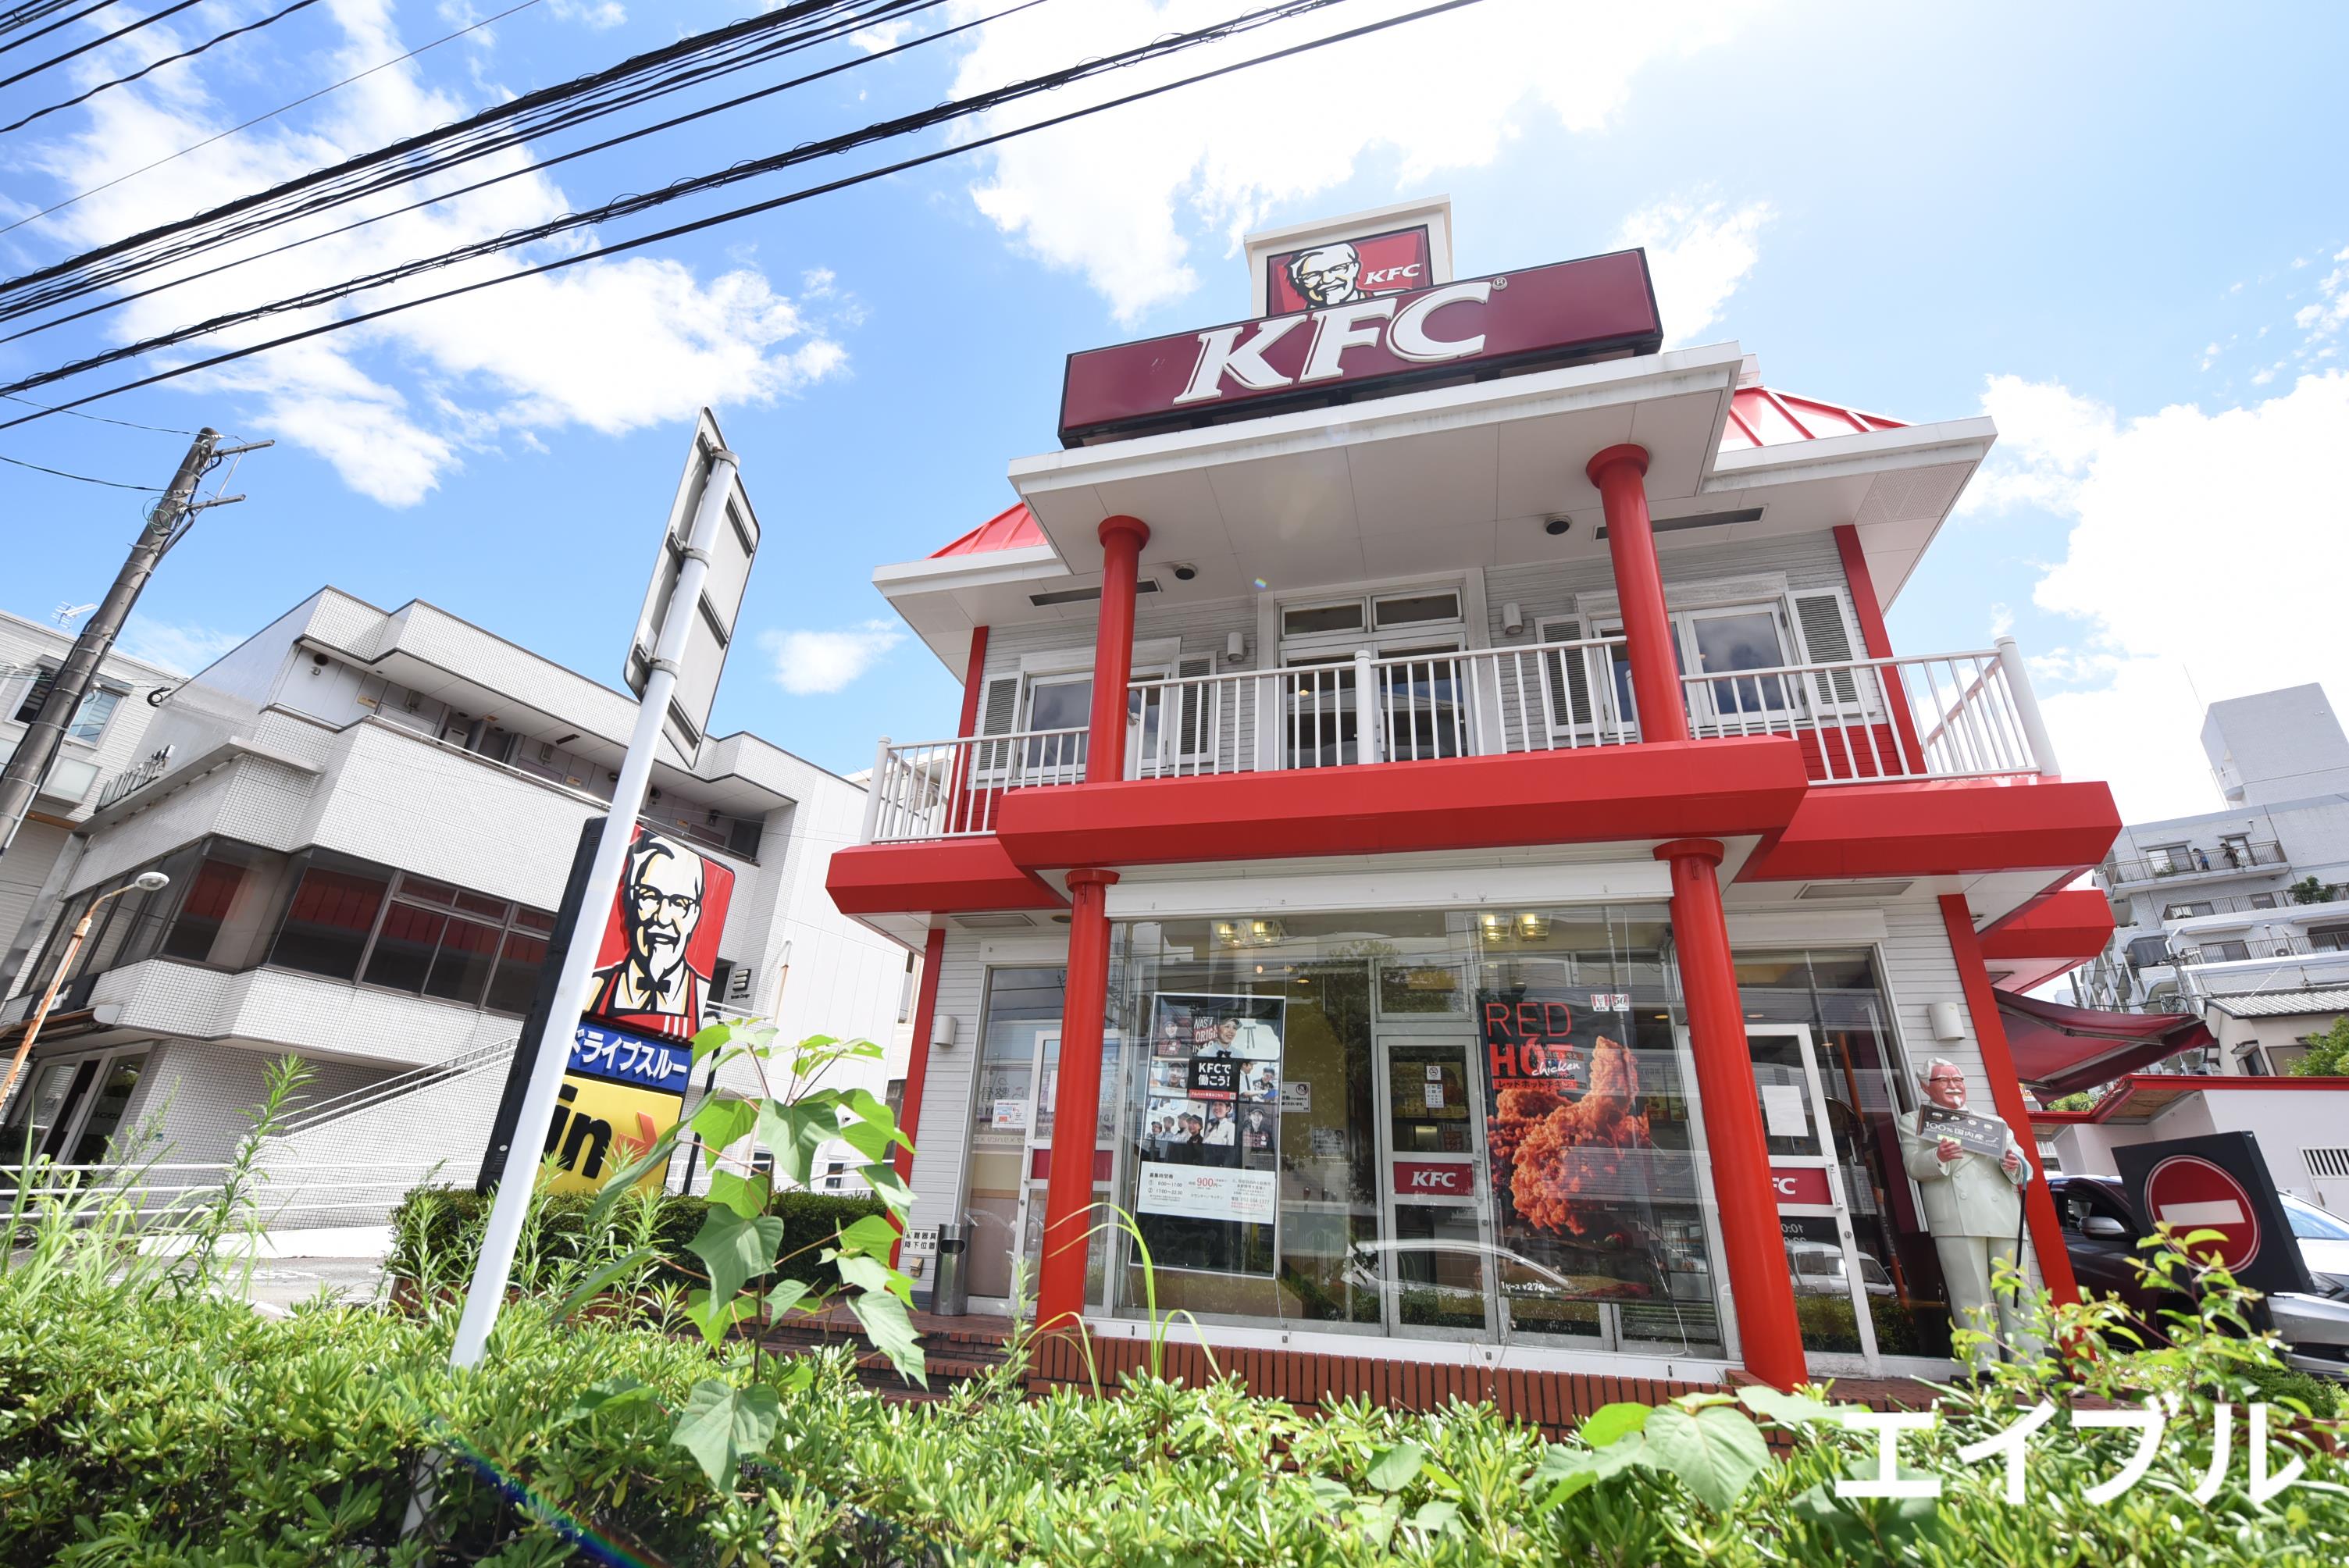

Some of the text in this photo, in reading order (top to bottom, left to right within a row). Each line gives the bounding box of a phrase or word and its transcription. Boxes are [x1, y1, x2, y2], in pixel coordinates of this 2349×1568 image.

[1364, 263, 1420, 285] KFC
[1173, 281, 1492, 405] KFC
[1486, 1002, 1573, 1037] RED
[1198, 1062, 1232, 1074] KFCで
[1531, 1060, 1581, 1076] chicken
[1410, 1171, 1456, 1187] KFC
